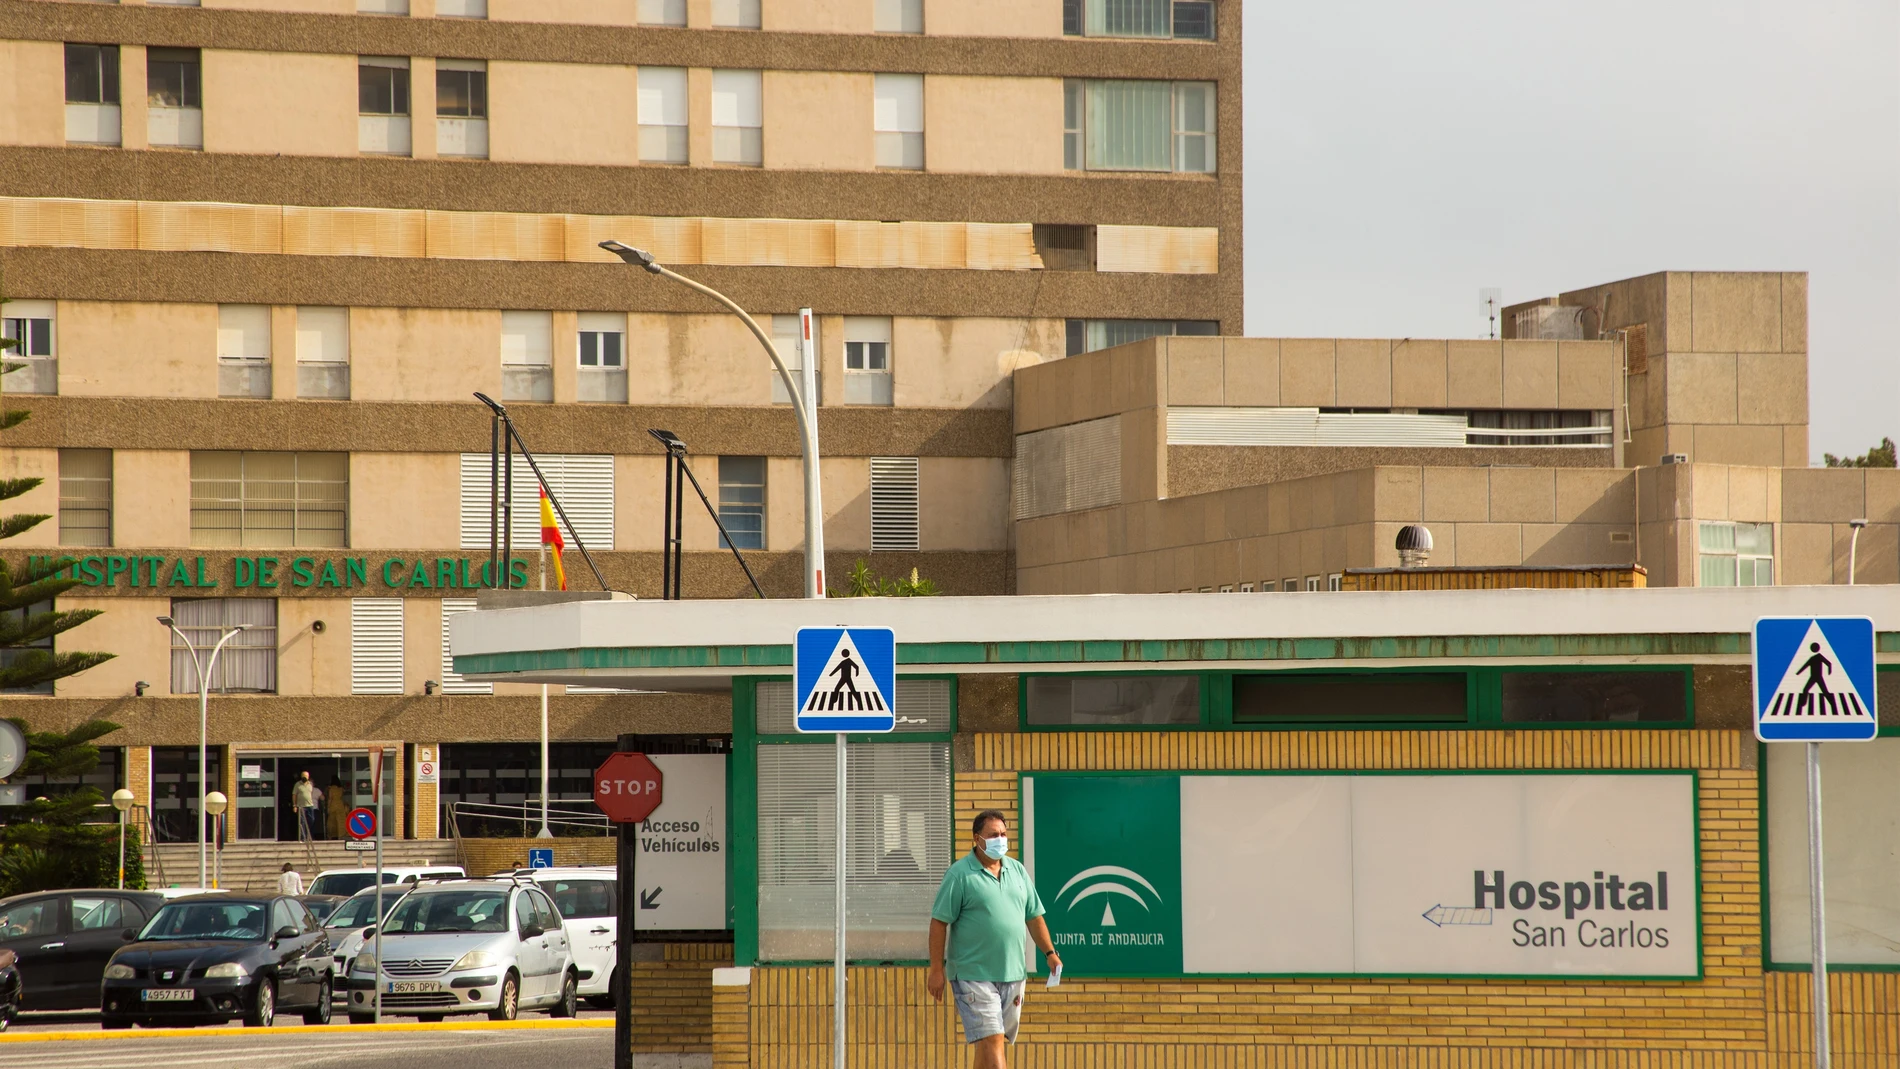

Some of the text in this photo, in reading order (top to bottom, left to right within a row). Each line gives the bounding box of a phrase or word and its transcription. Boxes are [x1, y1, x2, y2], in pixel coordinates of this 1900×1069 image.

[235, 557, 279, 588] DE
[292, 556, 367, 588] SAN
[383, 557, 529, 588] CARLOS
[599, 779, 657, 795] STOP
[641, 818, 700, 833] Acceso
[642, 837, 720, 853] Vehículos
[1474, 870, 1668, 919] Hospital
[1053, 933, 1165, 945] JUNTA DE ANDALUCIA
[1512, 918, 1669, 948] San Carlos
[147, 990, 192, 1000] 4957 FXT
[394, 982, 436, 992] 9676 DPV
